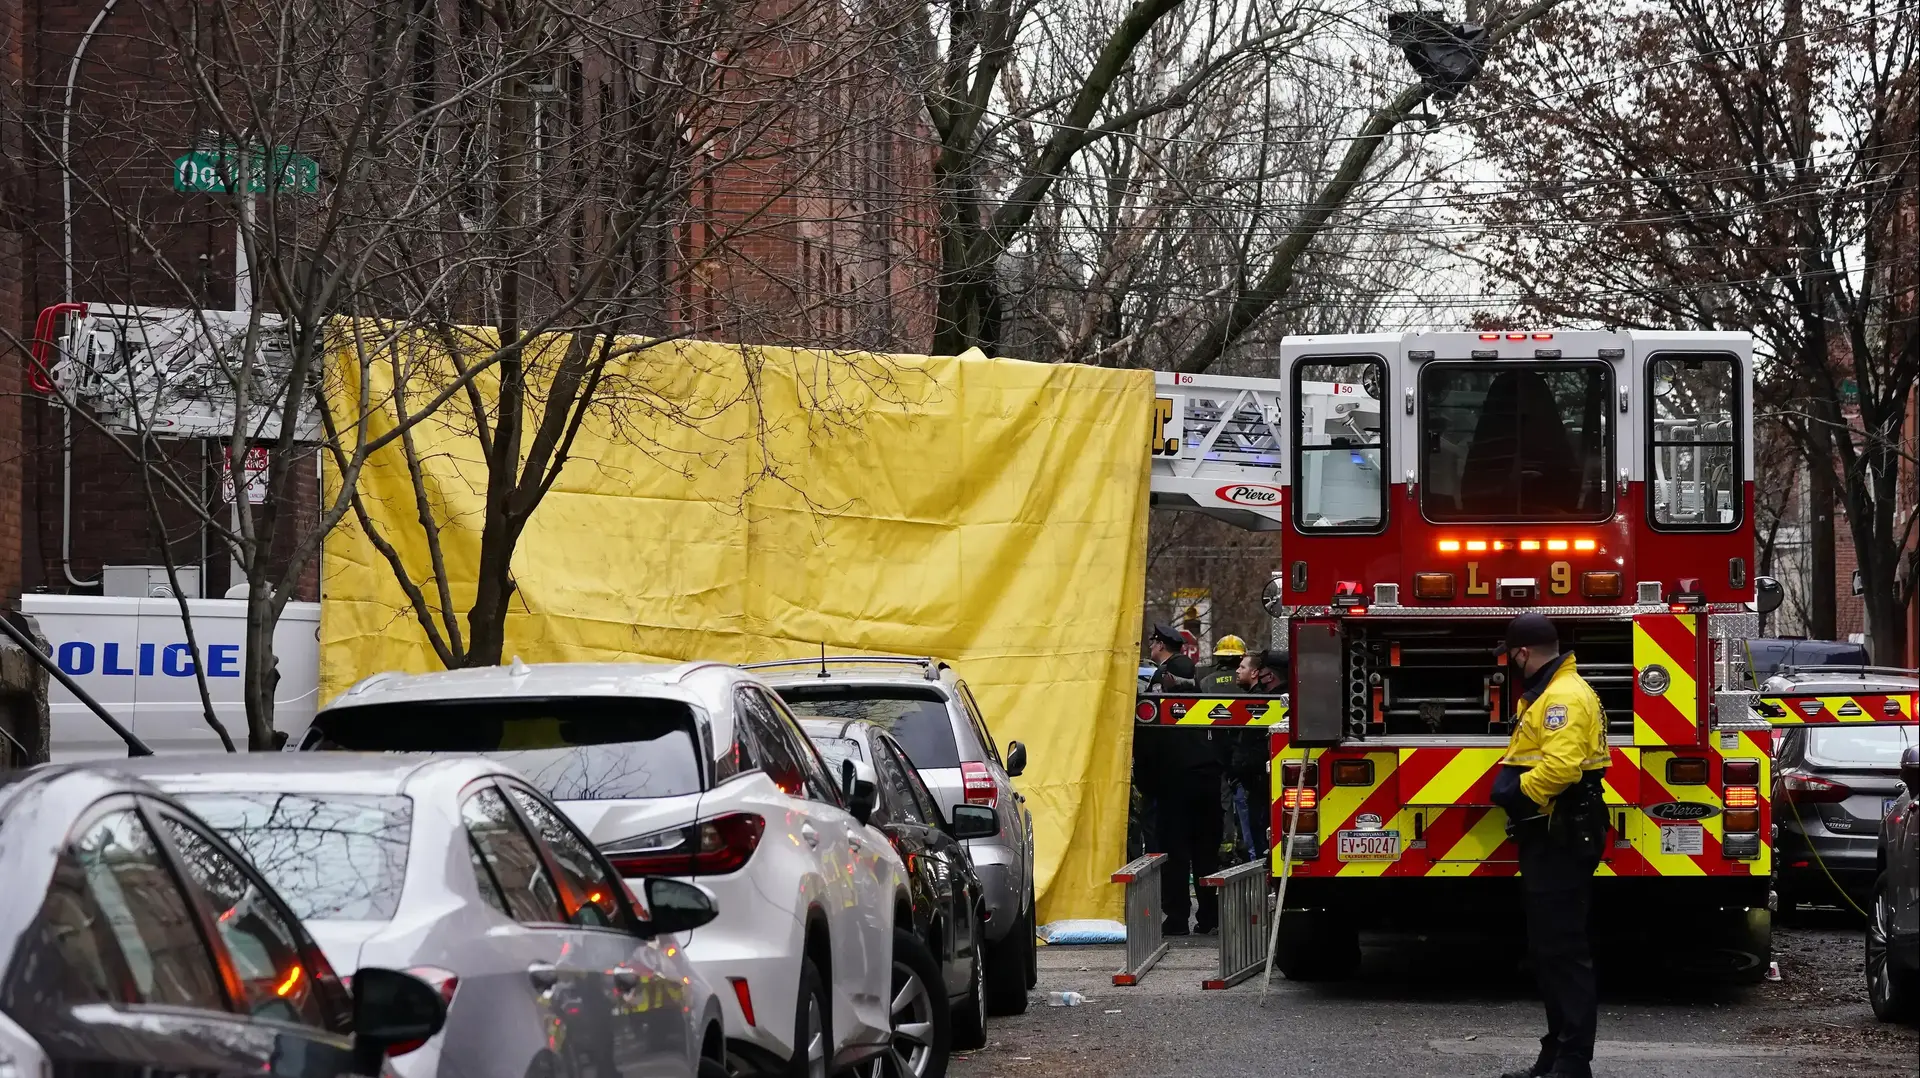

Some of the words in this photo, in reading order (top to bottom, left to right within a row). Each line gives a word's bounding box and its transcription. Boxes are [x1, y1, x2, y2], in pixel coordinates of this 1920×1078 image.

[1181, 376, 1193, 384] 60
[1341, 386, 1353, 394] 50
[1232, 487, 1276, 501] Pierce
[1467, 561, 1489, 595] L
[1550, 561, 1571, 595] 9
[50, 642, 240, 678] OLICE
[1216, 675, 1233, 684] WEST
[1660, 804, 1703, 816] Pierce
